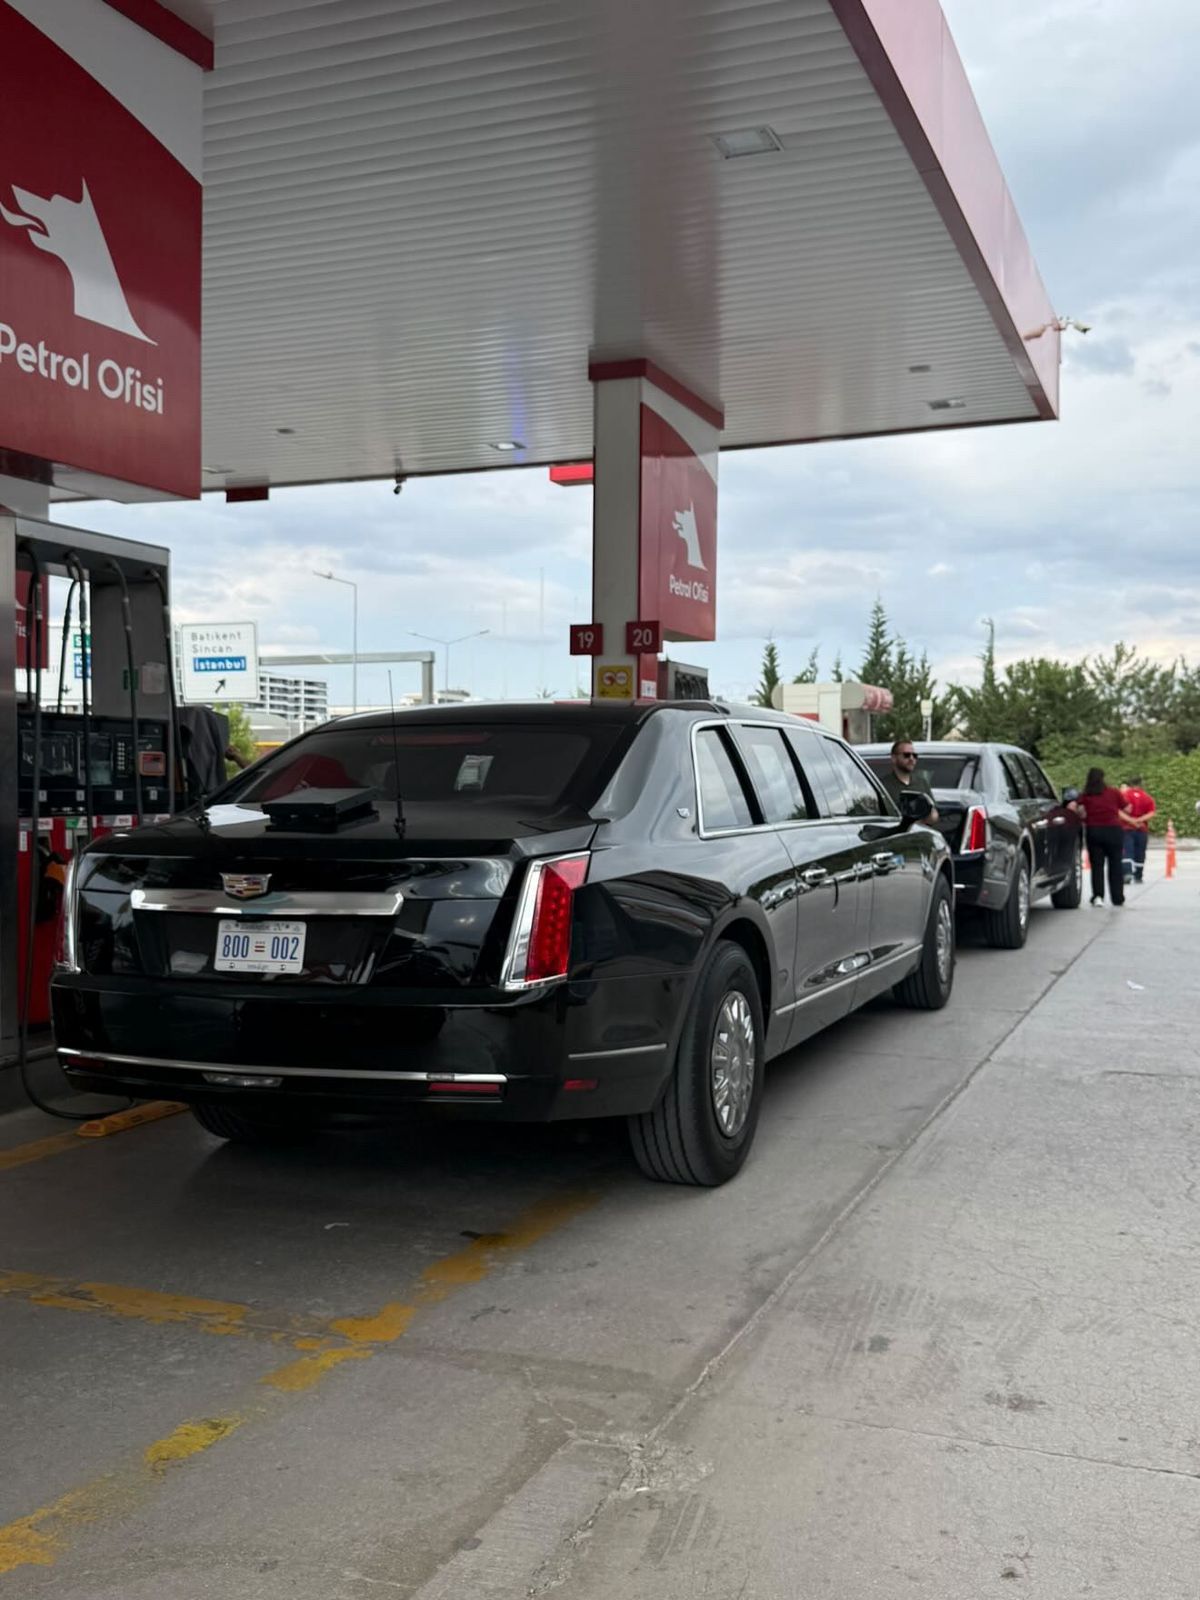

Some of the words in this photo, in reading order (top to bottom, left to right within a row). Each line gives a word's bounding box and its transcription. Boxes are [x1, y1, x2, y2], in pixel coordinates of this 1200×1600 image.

[0, 322, 90, 391] Petrol
[98, 359, 164, 414] Ofisi
[669, 574, 691, 599] Petrol
[692, 581, 709, 604] Ofisi
[192, 643, 233, 654] Sincan
[577, 631, 594, 648] 19
[632, 628, 652, 647] 20
[222, 934, 250, 958] 800
[271, 936, 300, 960] 002
